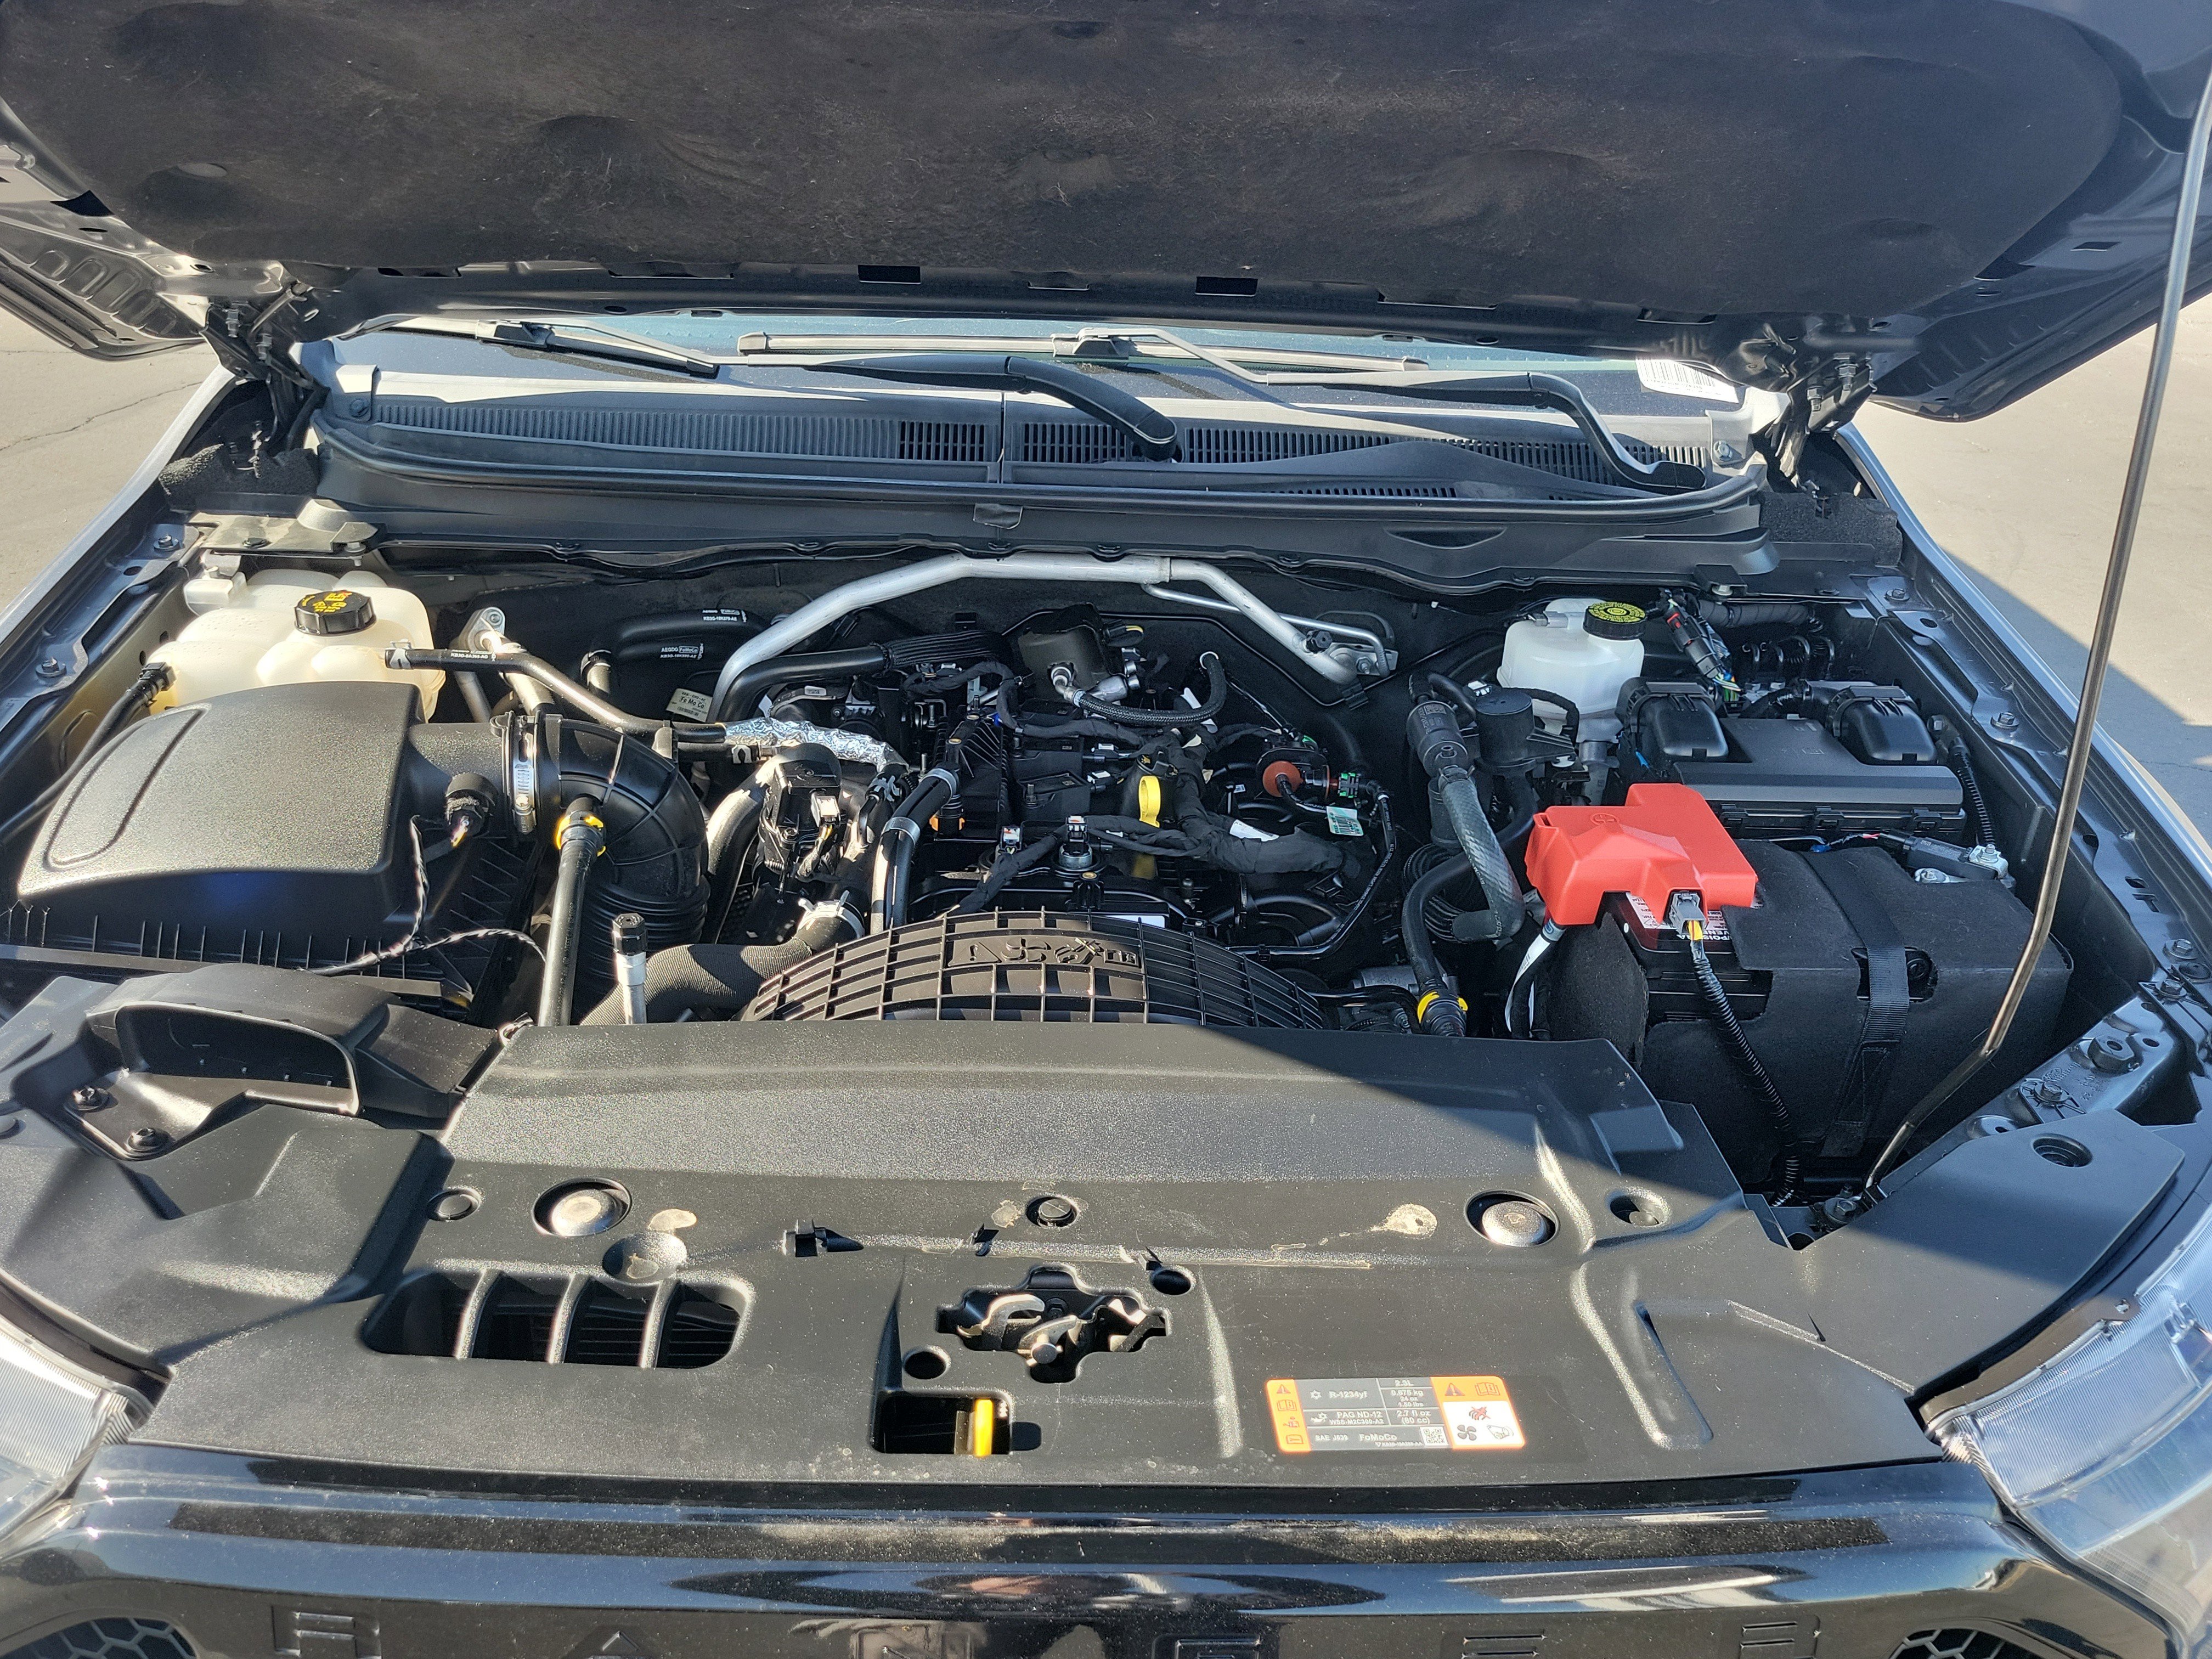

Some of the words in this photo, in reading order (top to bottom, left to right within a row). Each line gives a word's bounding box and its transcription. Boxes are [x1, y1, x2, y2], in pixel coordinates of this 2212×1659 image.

[1329, 1390, 1368, 1400] R-1234yf
[1413, 1389, 1424, 1397] kg
[1401, 1416, 1414, 1424] (80
[1417, 1416, 1430, 1425] cc)
[1359, 1433, 1397, 1441] FoMoCo
